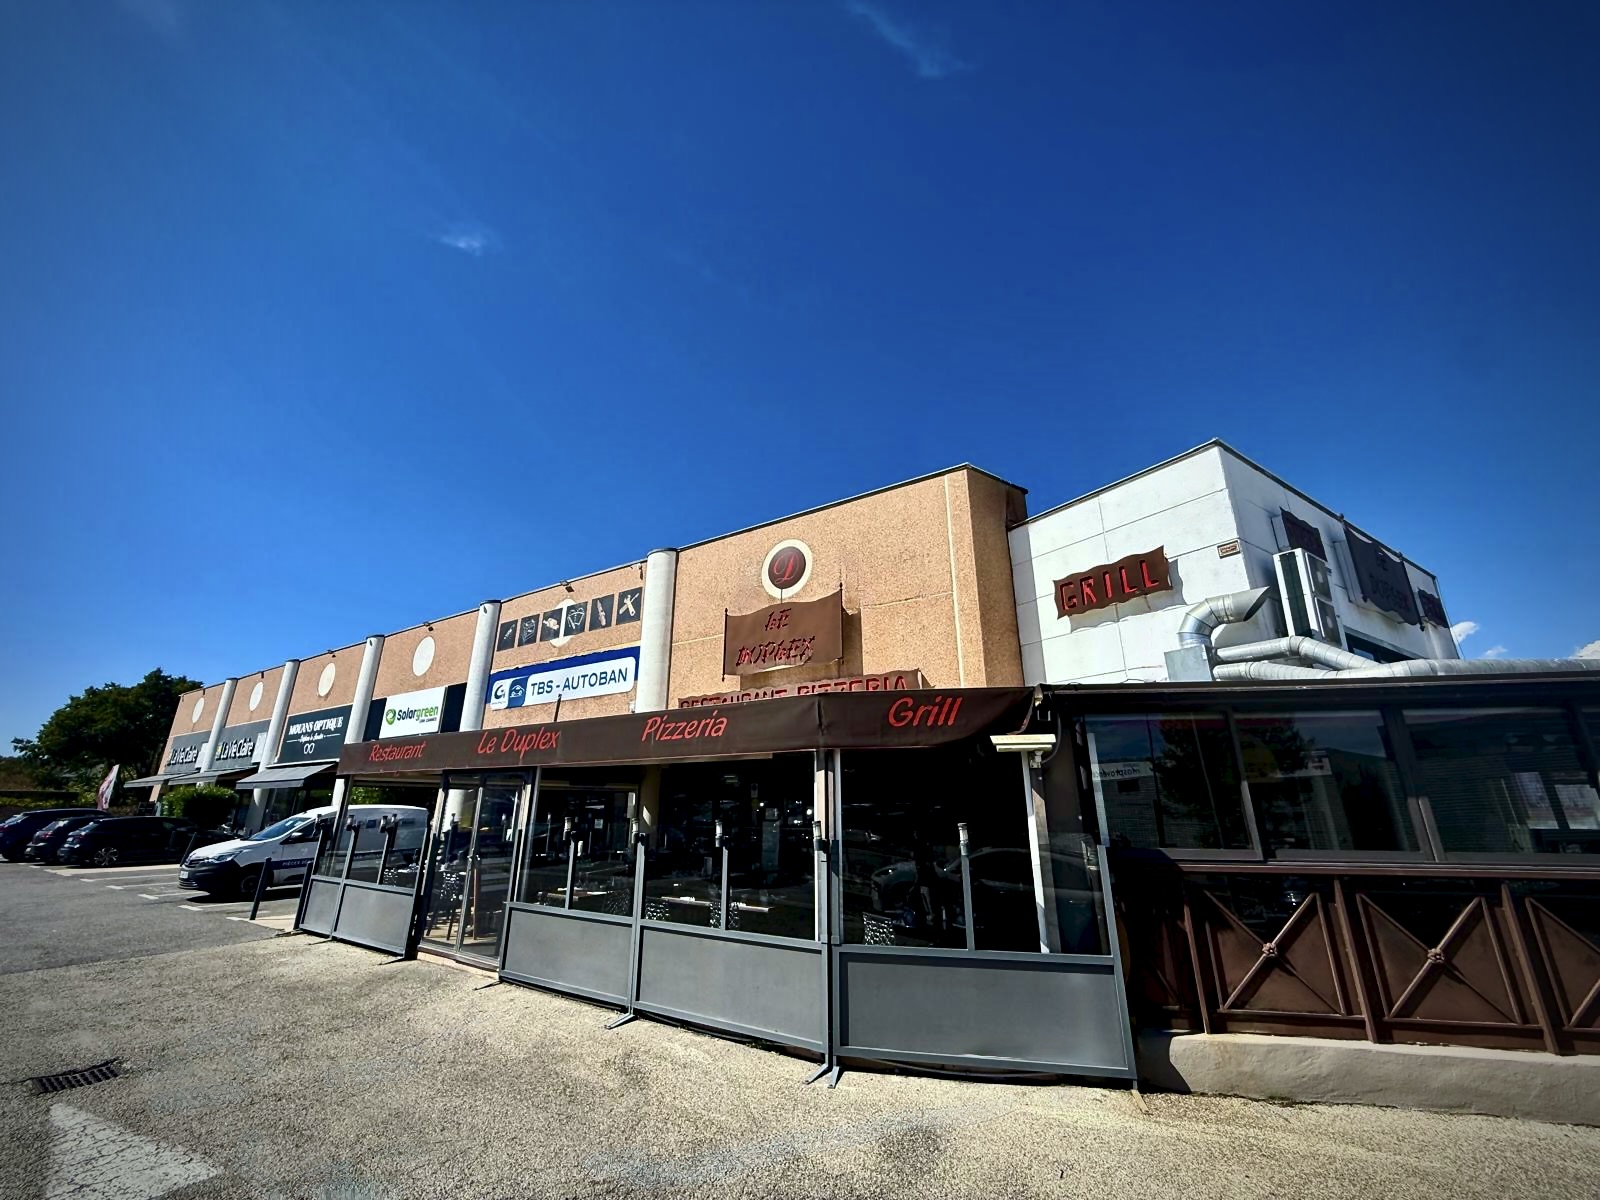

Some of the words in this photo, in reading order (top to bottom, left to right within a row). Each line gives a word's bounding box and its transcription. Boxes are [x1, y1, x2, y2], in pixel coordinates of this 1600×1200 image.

[1059, 559, 1160, 611] GRILL
[765, 608, 792, 631] LE
[736, 636, 816, 667] DUPLEX
[530, 680, 553, 696] TBS
[561, 667, 628, 692] AUTOBAN
[288, 721, 314, 735] MOUANS
[314, 716, 344, 731] OPTIQUE
[397, 706, 439, 721] Solargreen
[641, 709, 729, 742] Pizzeria
[887, 695, 964, 728] Grill
[236, 738, 255, 757] Claire
[368, 740, 426, 761] Restaurant
[477, 731, 498, 754] Le
[500, 726, 561, 759] Duplex
